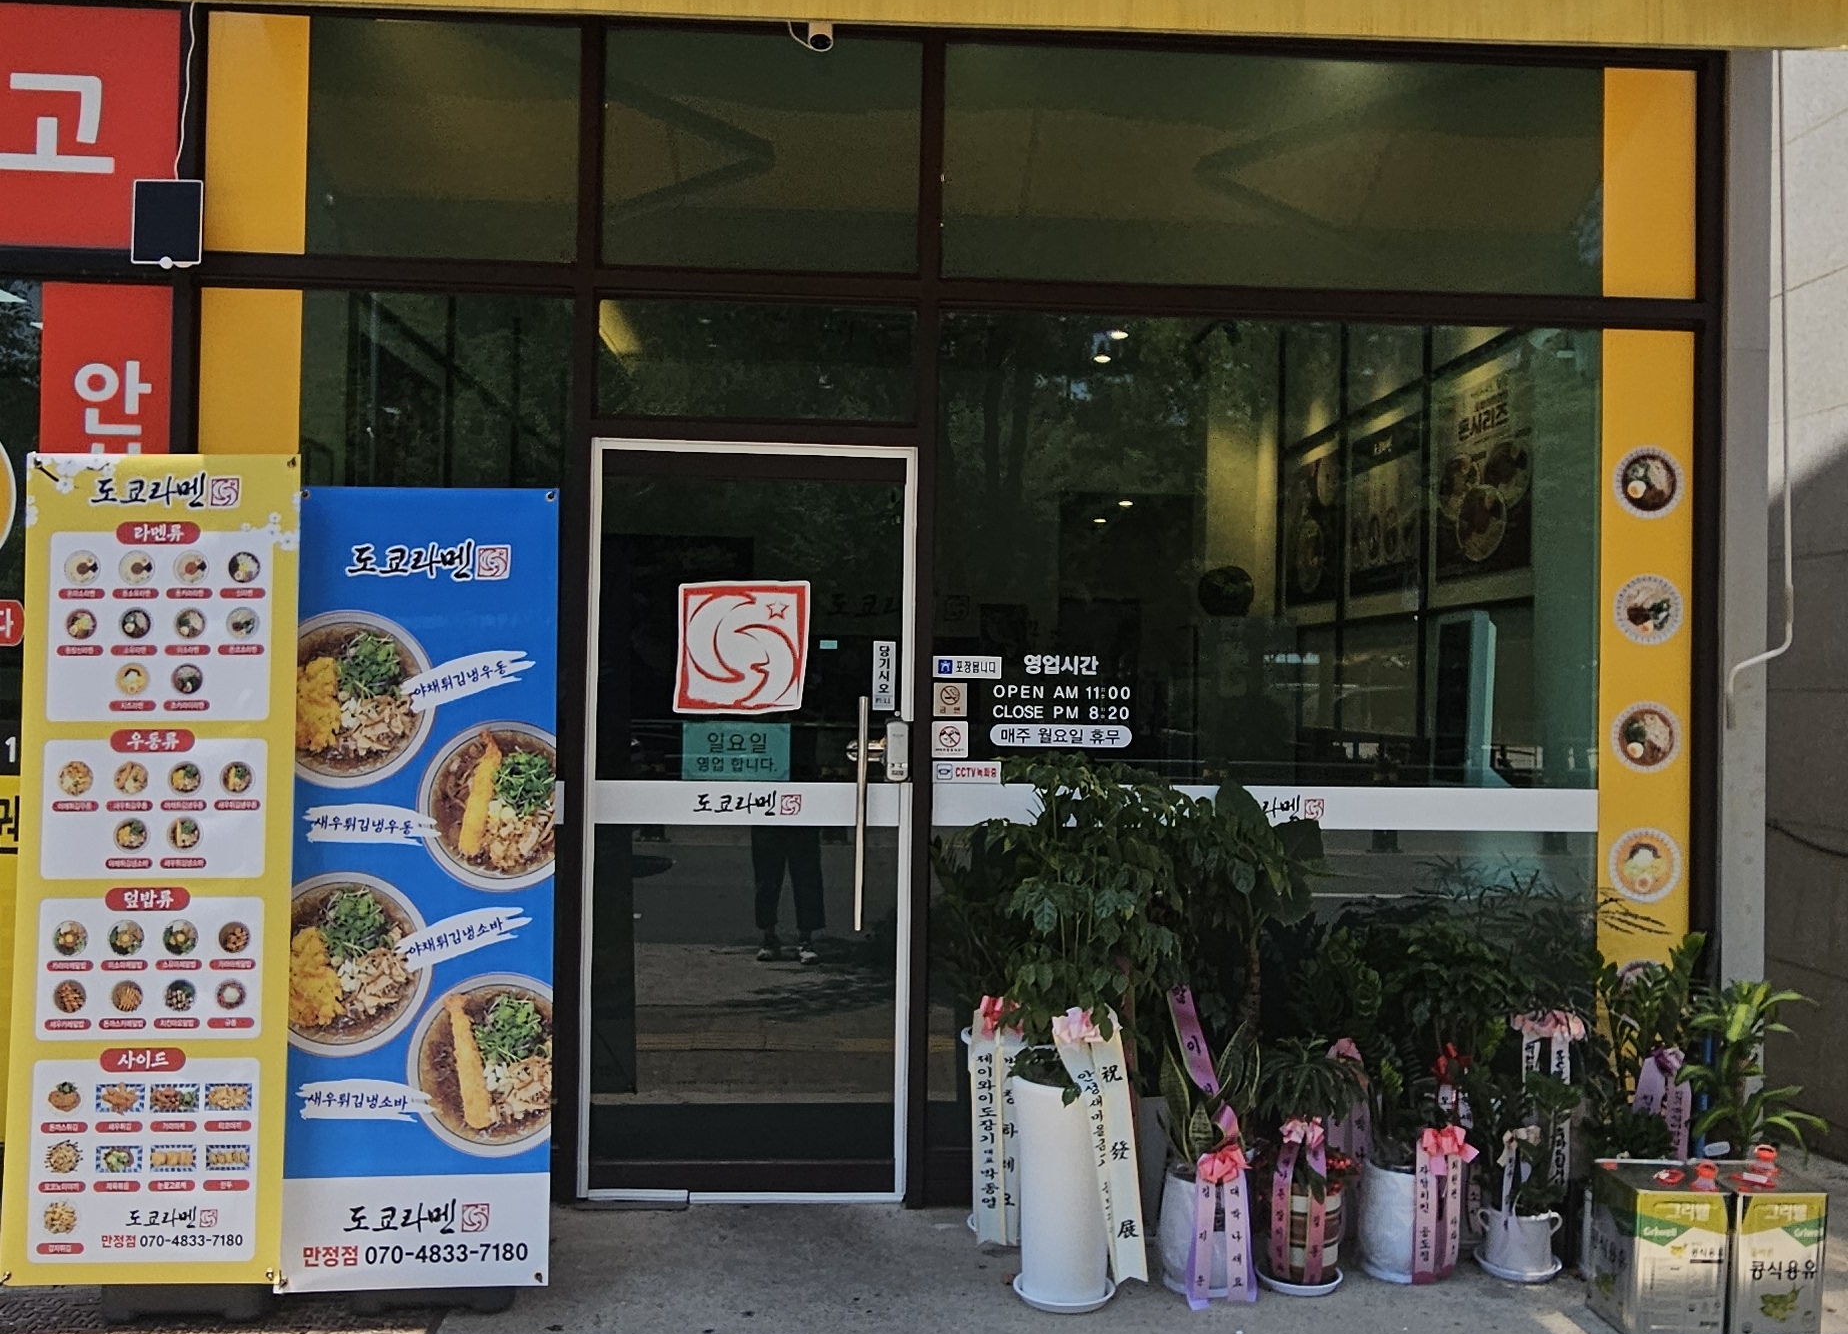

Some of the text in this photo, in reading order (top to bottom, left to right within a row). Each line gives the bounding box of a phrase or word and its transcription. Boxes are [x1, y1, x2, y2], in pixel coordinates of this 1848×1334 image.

[91, 472, 207, 508] 도코라멘
[134, 523, 184, 543] 라멘류
[347, 539, 474, 579] 도코라멘
[878, 645, 891, 694] 당기시오
[1023, 654, 1099, 676] 영업시간
[413, 659, 508, 698] 야채튀김냉우동
[992, 684, 1131, 700] OPEN AM 11:00
[992, 705, 1130, 720] CLOSE PM 8:20
[127, 731, 180, 751] 우동류
[707, 732, 768, 754] 일요일
[1000, 728, 1121, 745] 매주 월요일 휴무
[696, 755, 778, 772] 영업 합니다.
[693, 790, 777, 816] 도코라멘
[313, 814, 414, 835] 새우튀김냉우동
[123, 889, 175, 909] 덮밥류
[406, 916, 504, 956] 야채튀김냉소바
[117, 1049, 170, 1069] 사이드
[306, 1091, 408, 1111] 새우튀김냉소바
[125, 1205, 197, 1229] 도코라멘
[343, 1198, 457, 1234] 도코라멘
[101, 1233, 243, 1248] 만정점 070-4833-7180
[302, 1242, 528, 1268] 만정점 070-4833-7180
[1750, 1259, 1818, 1280] 콩식용유
